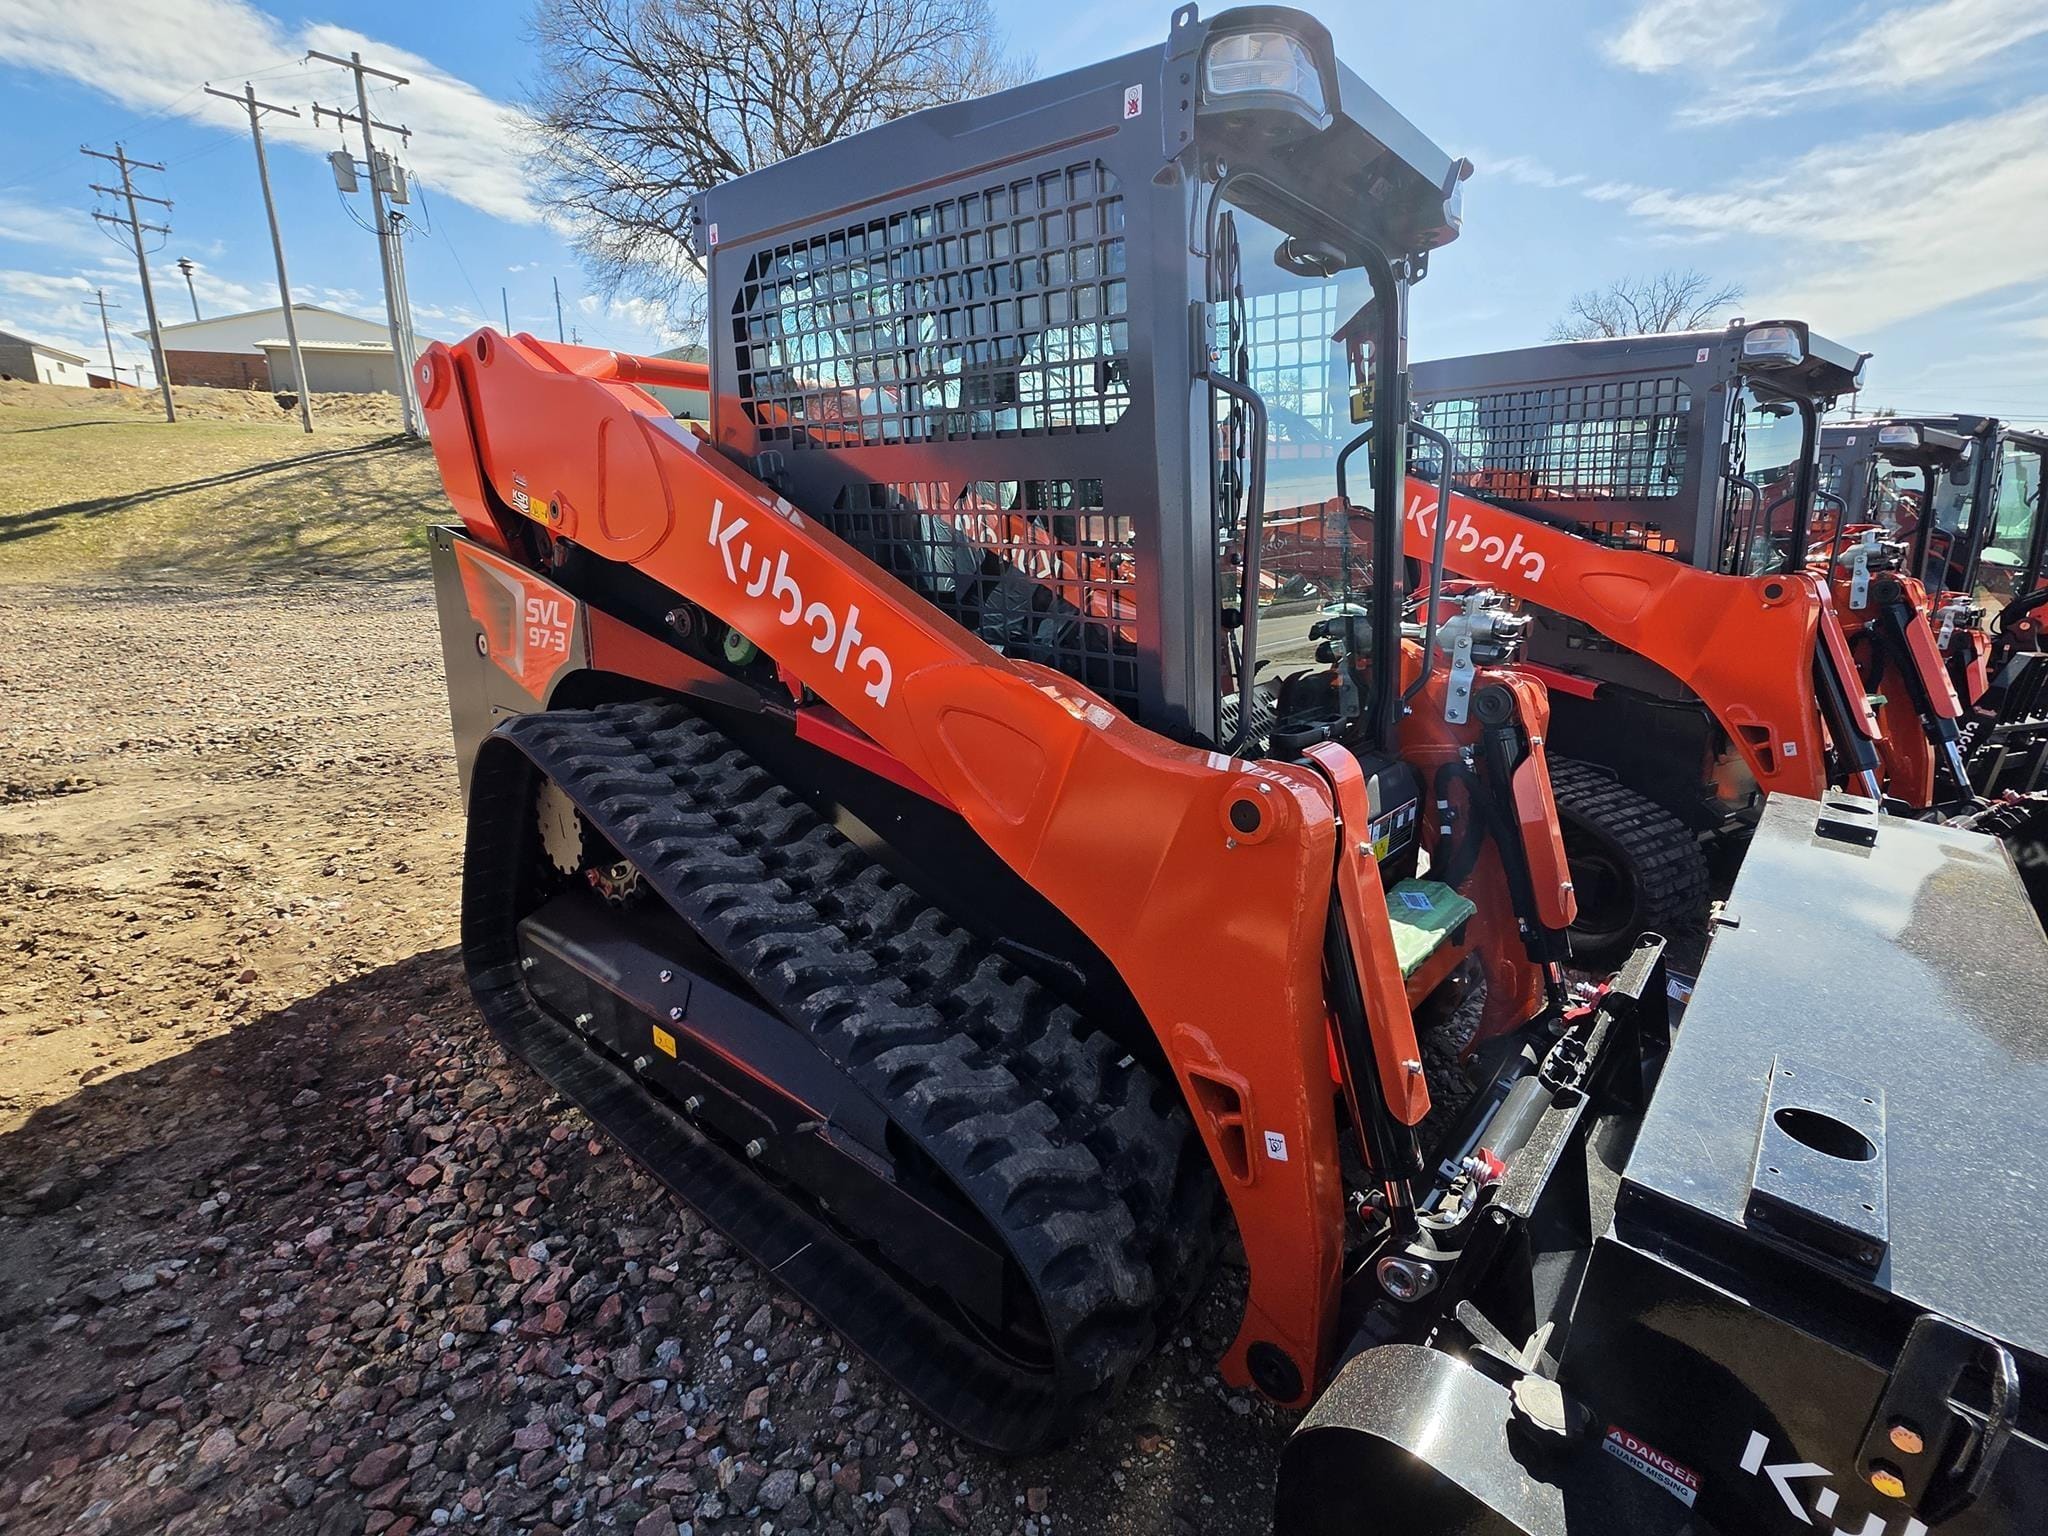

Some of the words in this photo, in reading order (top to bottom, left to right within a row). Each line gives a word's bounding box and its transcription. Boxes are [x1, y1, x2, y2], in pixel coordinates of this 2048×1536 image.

[526, 598, 567, 629] SVL
[708, 498, 892, 708] Kubota
[529, 627, 565, 652] 97-3
[1608, 1444, 1644, 1470] GUARD
[1646, 1466, 1688, 1497] MISSING
[1625, 1438, 1697, 1487] DANGER
